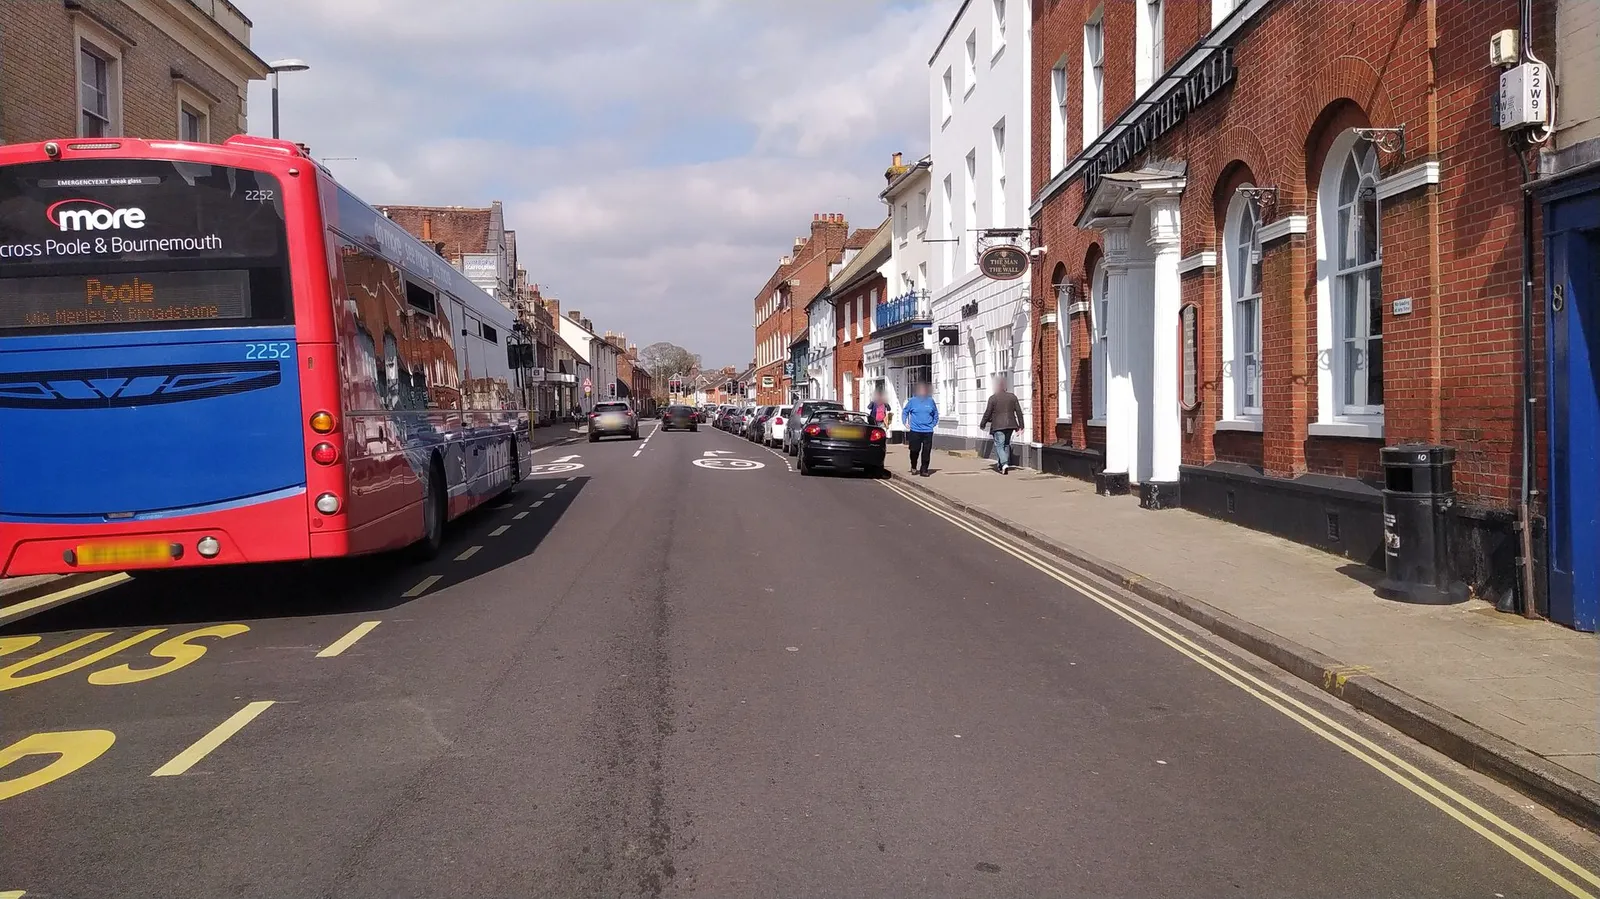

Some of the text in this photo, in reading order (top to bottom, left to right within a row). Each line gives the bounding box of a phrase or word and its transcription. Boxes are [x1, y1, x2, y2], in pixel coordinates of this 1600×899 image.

[1105, 132, 1133, 173] MAN
[1133, 121, 1151, 156] IN
[1151, 89, 1183, 142] THE
[1184, 47, 1235, 114] WALL
[127, 177, 142, 185] glass
[245, 190, 274, 201] 2252
[58, 207, 146, 232] more
[46, 239, 91, 256] Poole
[95, 238, 108, 254] &
[111, 234, 223, 252] Bournemouth
[85, 277, 155, 305] Poole
[1552, 284, 1563, 312] 8
[25, 305, 219, 326] via Merley & Broadstone
[245, 343, 291, 360] 2252
[1418, 453, 1427, 462] 10
